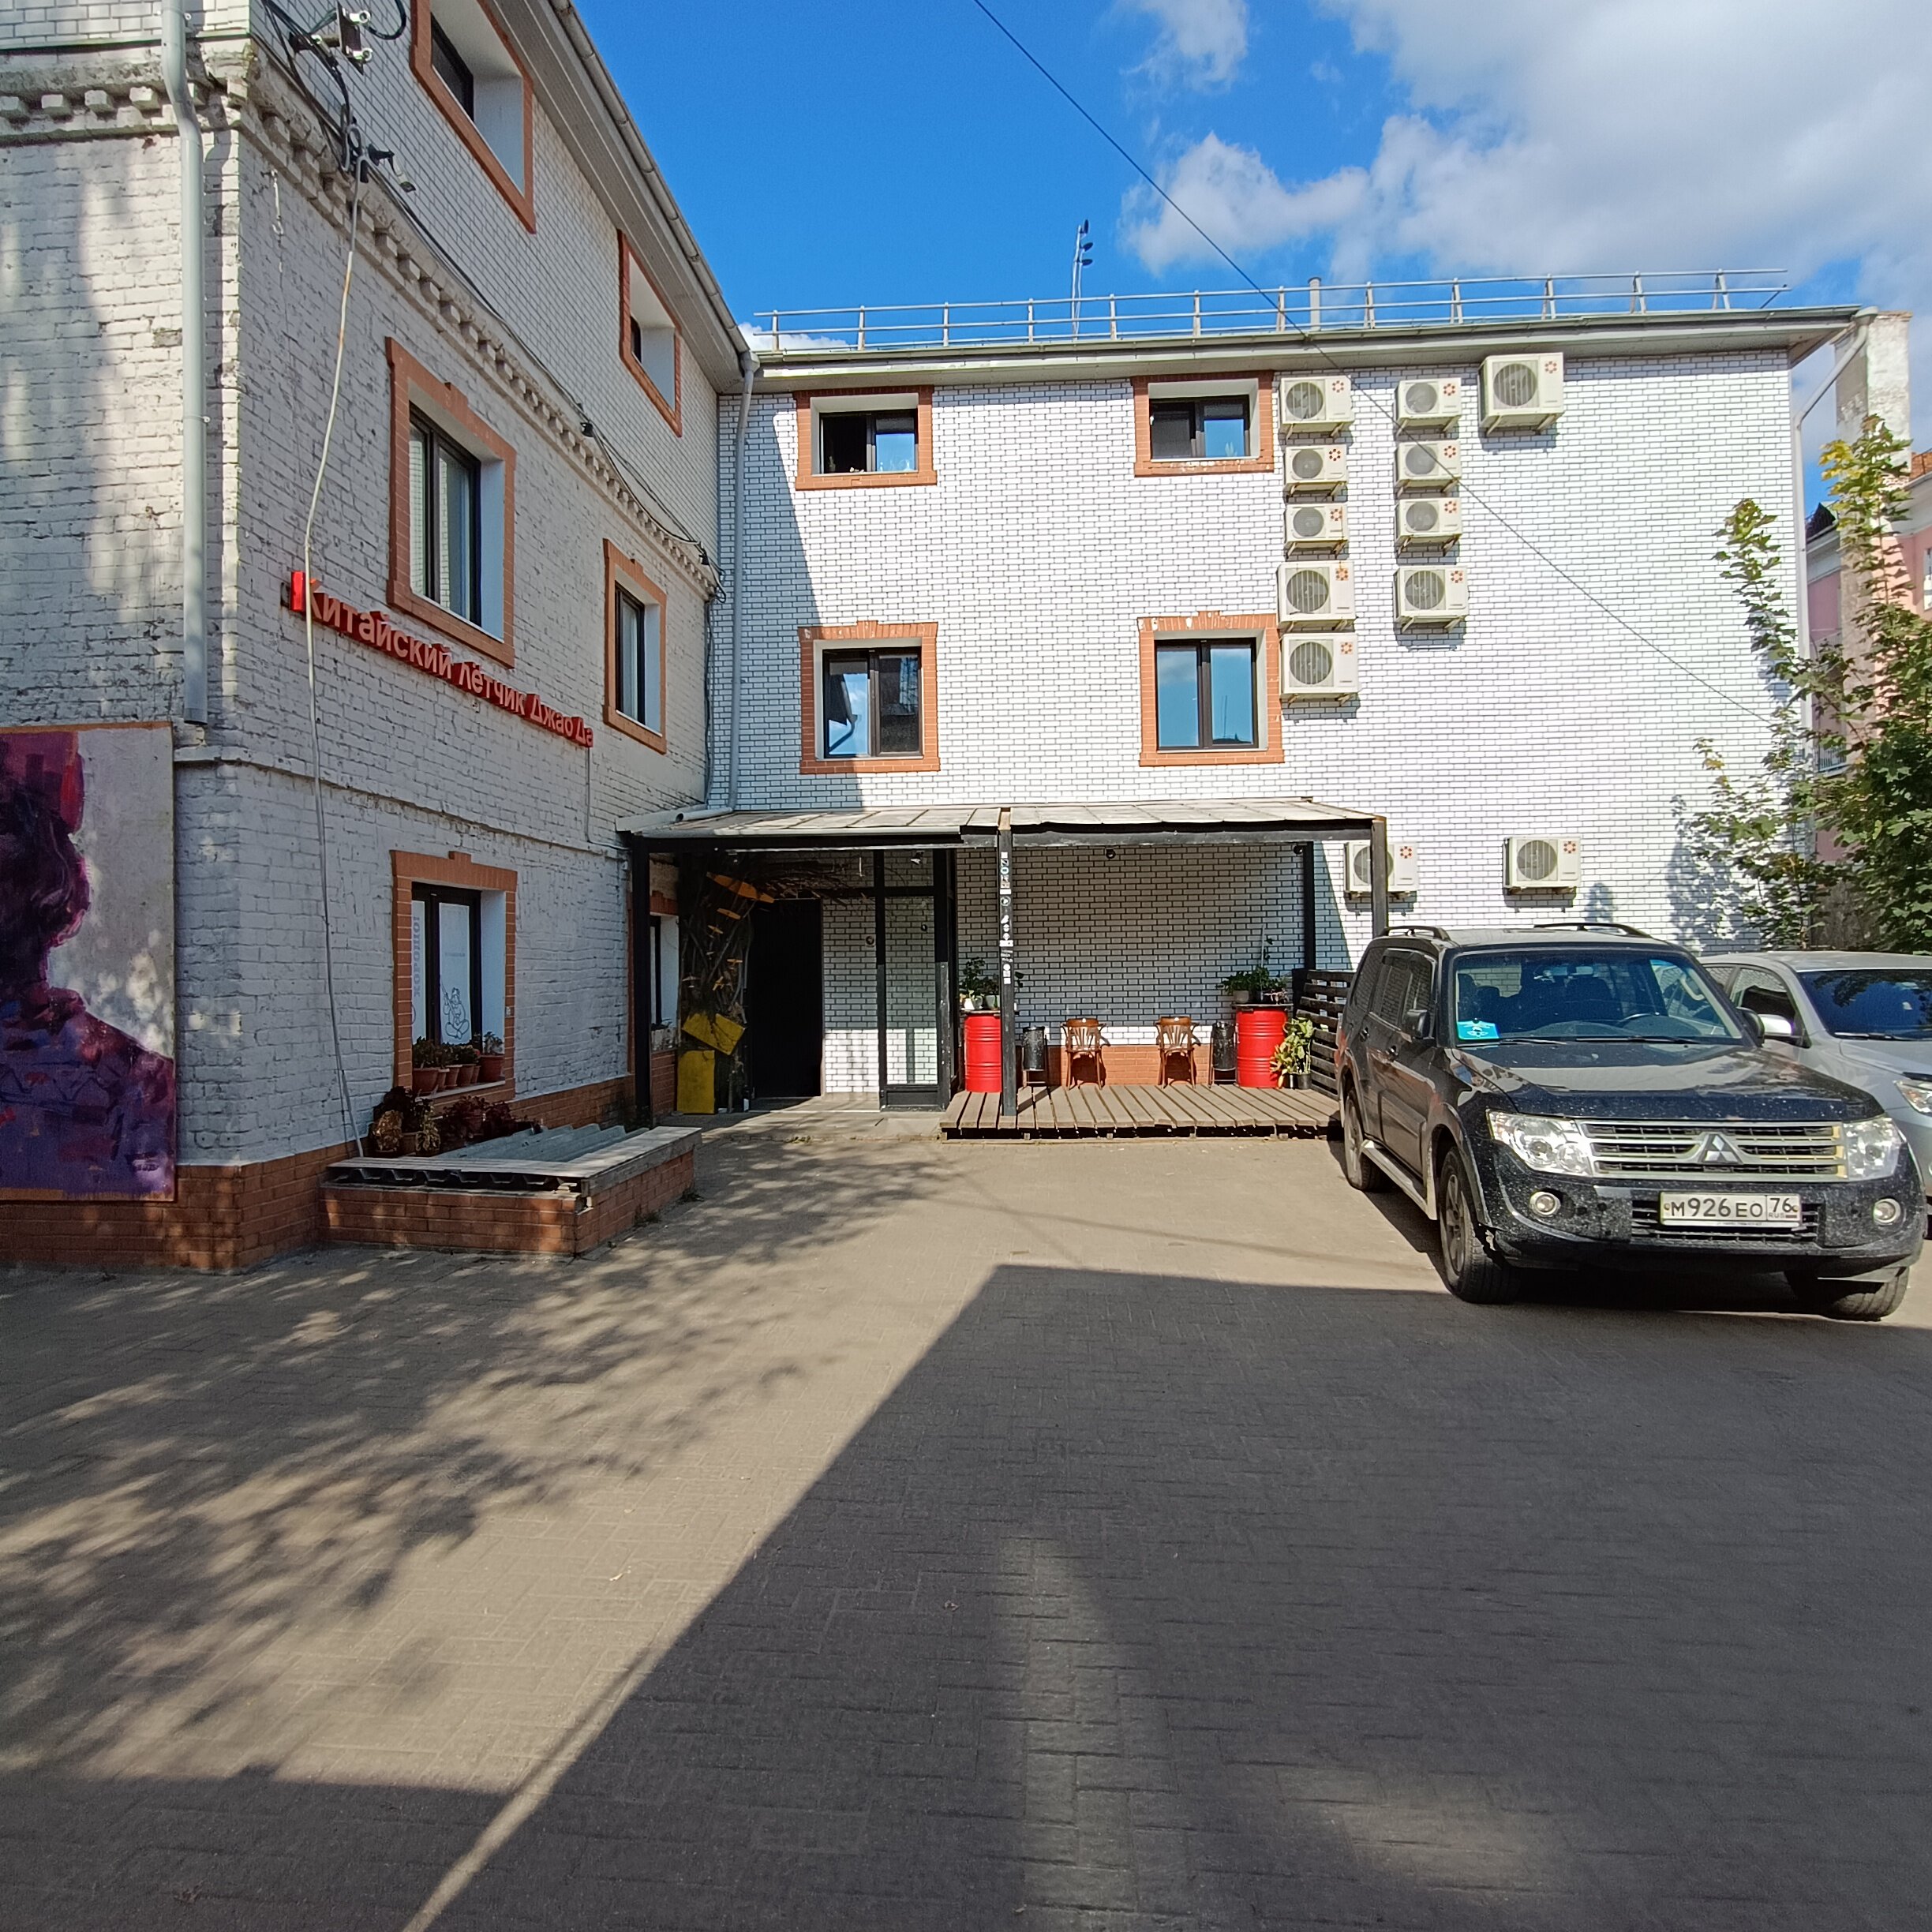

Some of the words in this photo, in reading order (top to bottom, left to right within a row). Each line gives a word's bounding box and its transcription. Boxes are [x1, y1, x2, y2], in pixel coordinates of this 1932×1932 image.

[528, 694, 574, 739] Джао
[572, 717, 593, 747] Да
[1671, 1197, 1763, 1218] М926ЕО
[1769, 1197, 1793, 1213] 76
